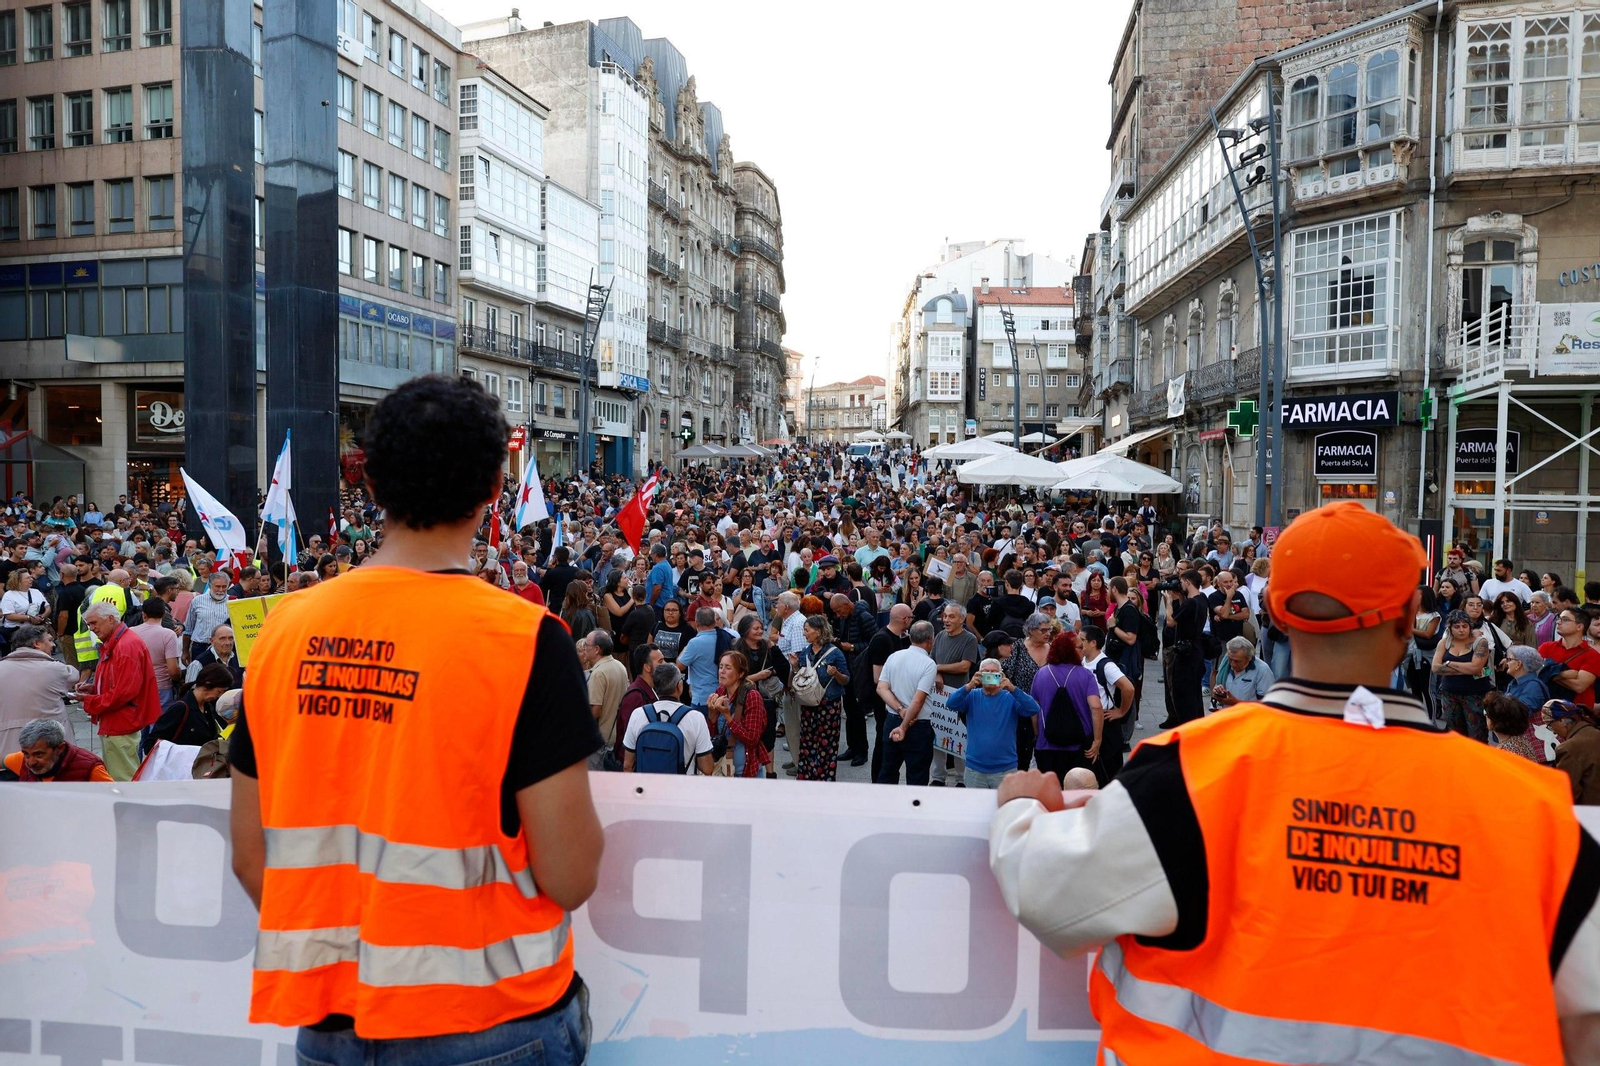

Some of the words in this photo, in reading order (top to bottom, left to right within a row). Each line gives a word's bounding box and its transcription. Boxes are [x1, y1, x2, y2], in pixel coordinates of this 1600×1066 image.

[387, 312, 410, 325] OCASO
[1281, 399, 1390, 424] FARMACIA
[1318, 445, 1373, 457] FARMACIA
[1456, 456, 1479, 464] Puerta
[1479, 456, 1491, 464] del
[1351, 460, 1364, 468] Sol,
[245, 613, 257, 621] 15%
[306, 636, 395, 662] SINDICATO
[299, 663, 325, 686] DE
[325, 664, 416, 697] INQUILINAS
[298, 694, 341, 717] VIGO
[344, 697, 371, 720] TUI
[372, 700, 394, 724] BM
[1292, 797, 1416, 834] SINDICATO
[1290, 829, 1321, 858] DE
[1322, 833, 1458, 876] INQUILINAS
[1292, 865, 1343, 894] VIGO
[1348, 872, 1386, 899] TUI
[1391, 877, 1429, 905] BM
